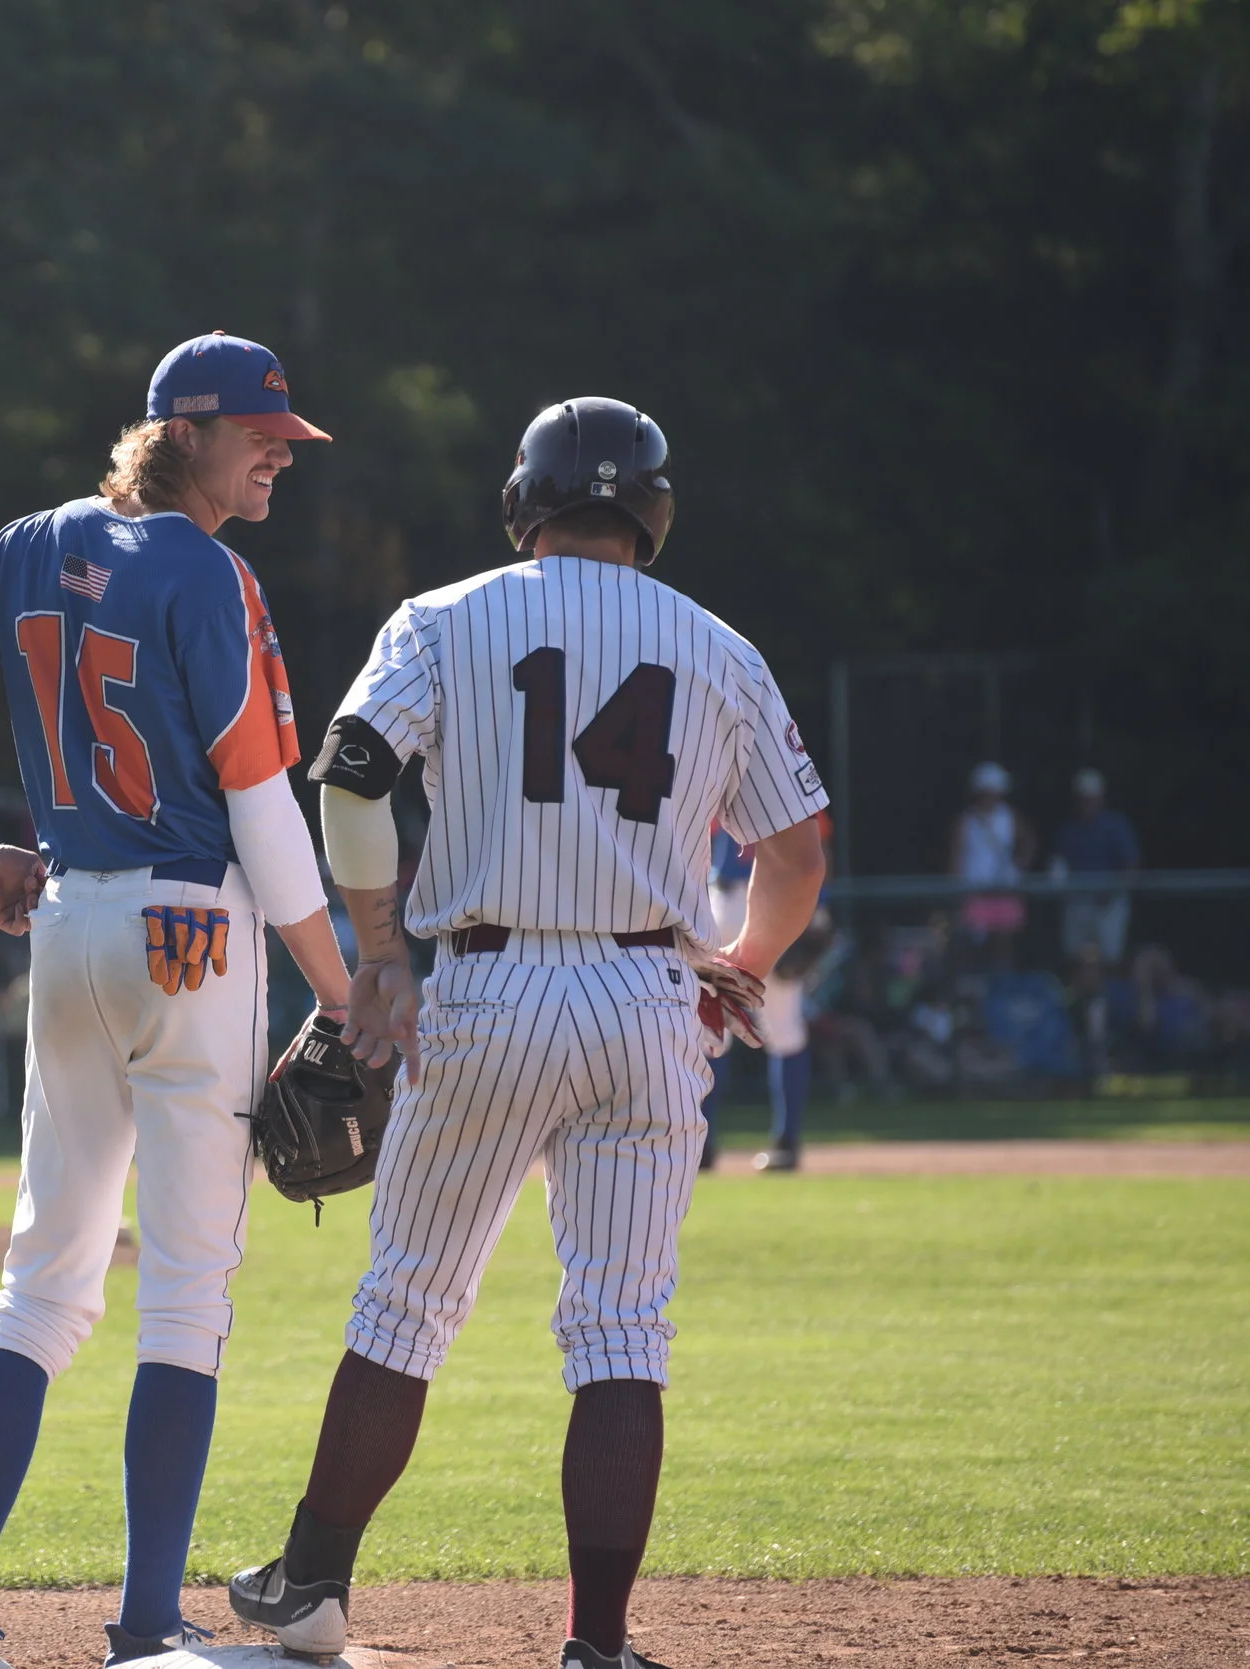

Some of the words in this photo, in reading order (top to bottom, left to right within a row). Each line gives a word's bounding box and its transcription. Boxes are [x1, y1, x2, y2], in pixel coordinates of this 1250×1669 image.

[15, 610, 160, 825] 15
[513, 646, 676, 825] 14
[341, 1116, 365, 1157] marucci
